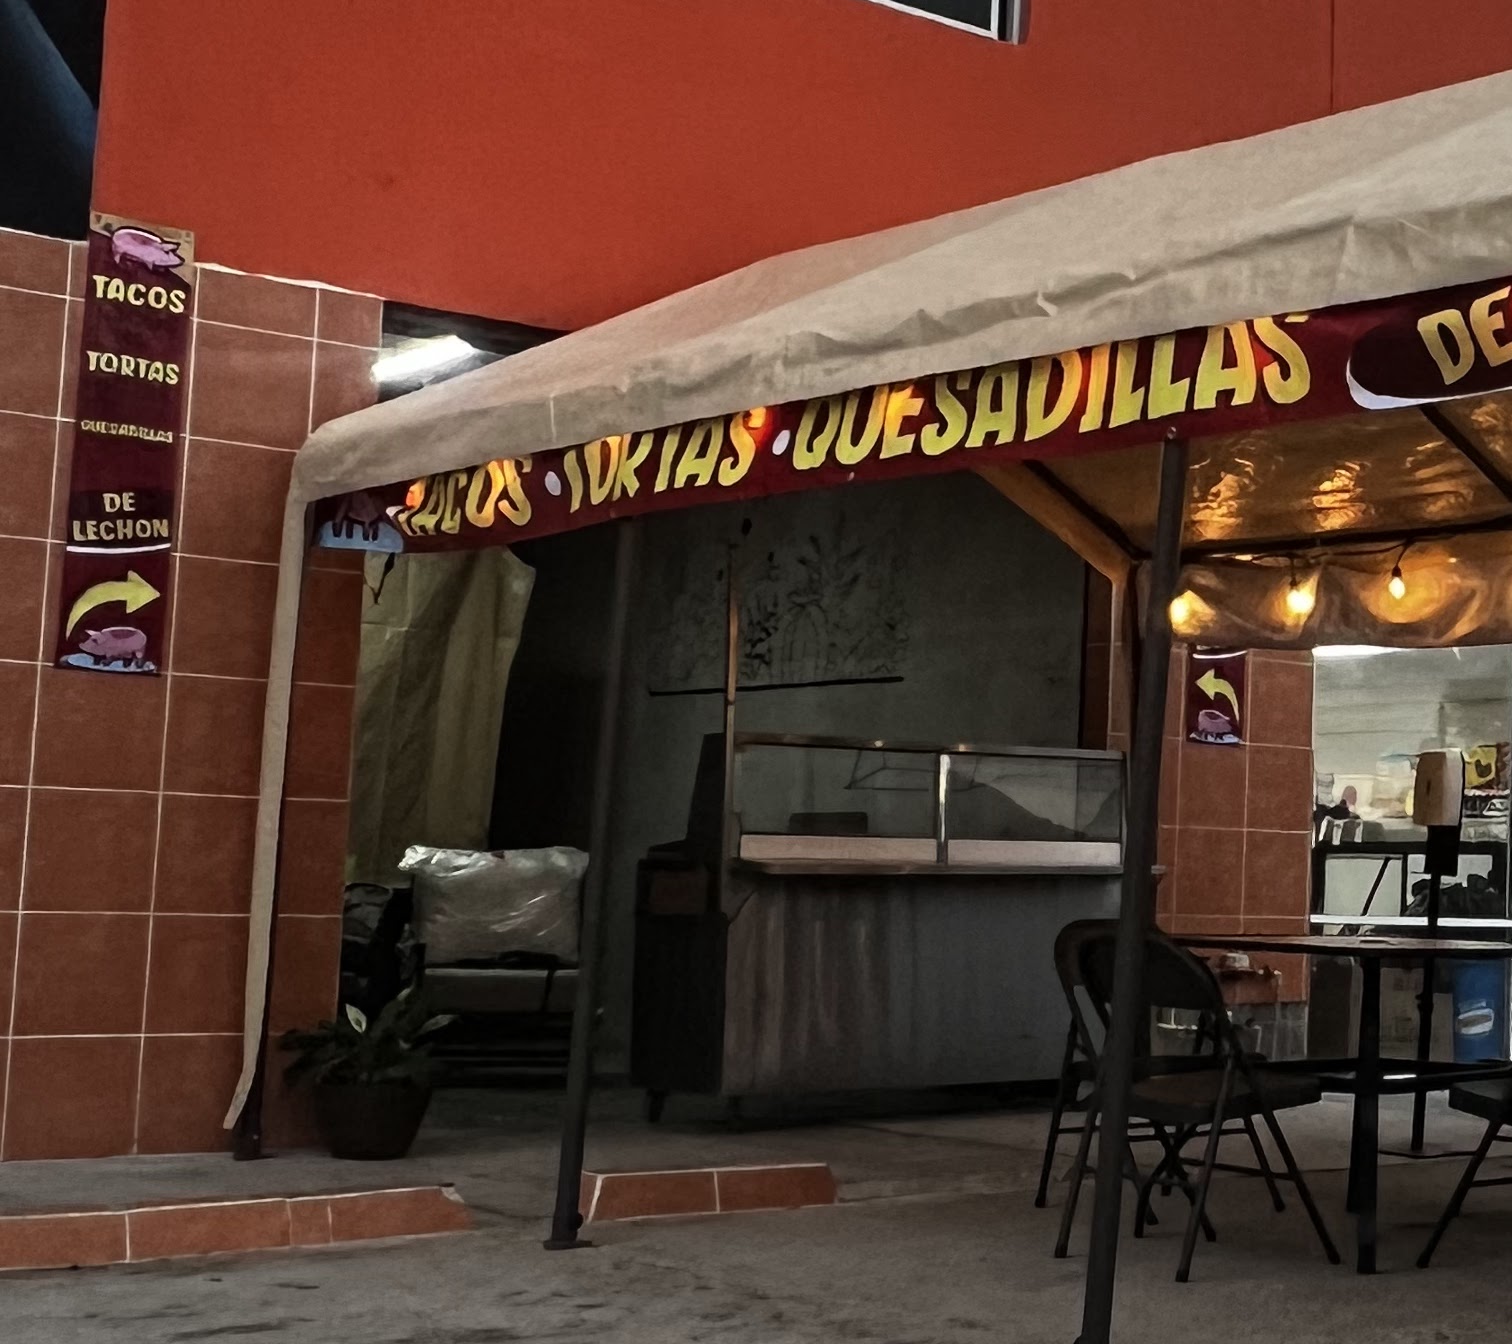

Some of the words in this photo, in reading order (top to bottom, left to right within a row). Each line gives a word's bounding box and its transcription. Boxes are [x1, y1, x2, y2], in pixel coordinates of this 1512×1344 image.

[92, 274, 186, 314] TACOS
[86, 350, 180, 385] TORTAS
[792, 315, 1311, 471] QUESADILLAS
[102, 492, 136, 513] DE
[72, 519, 169, 542] LECHON
